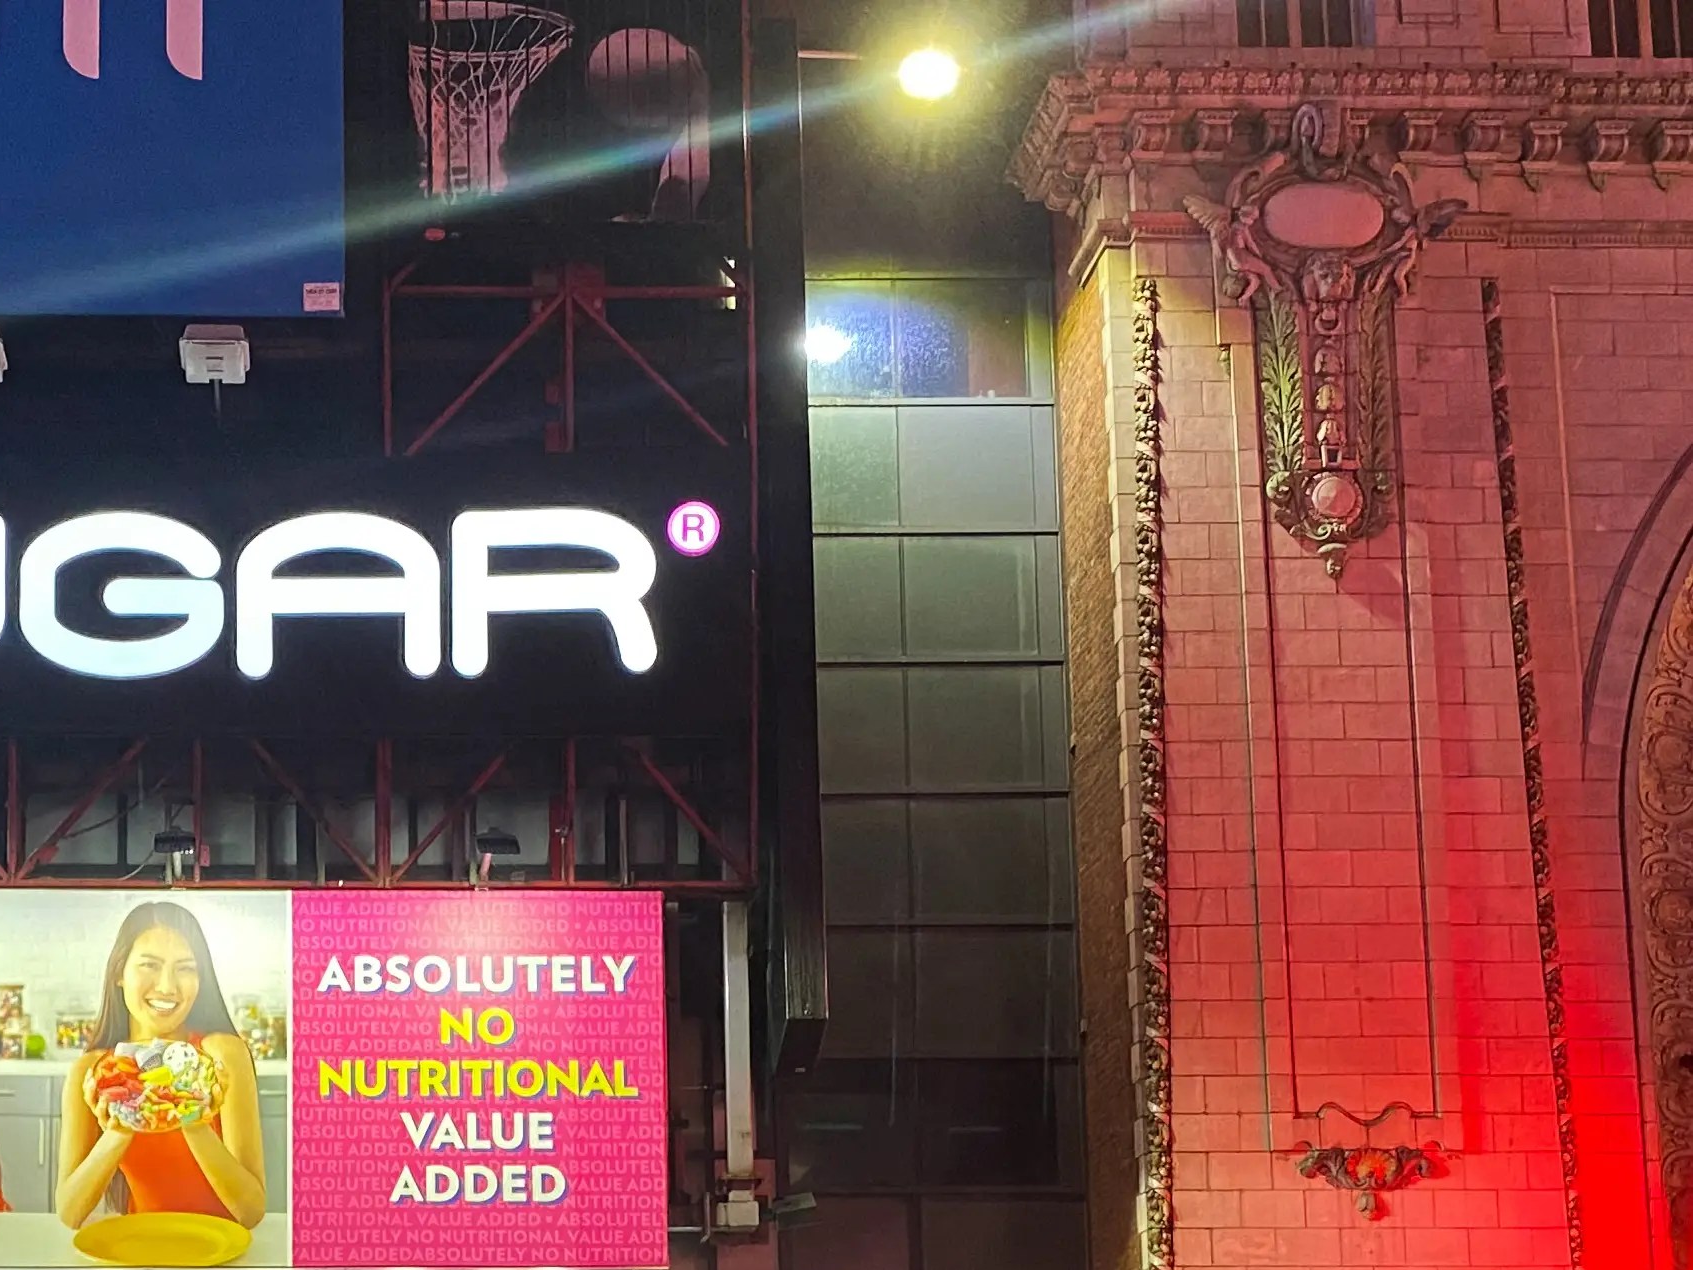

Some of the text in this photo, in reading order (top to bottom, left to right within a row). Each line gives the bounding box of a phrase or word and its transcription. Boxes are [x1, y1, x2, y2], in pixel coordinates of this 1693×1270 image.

[317, 954, 636, 995] ABSOLUTELY
[439, 1007, 516, 1046] NO
[318, 1059, 640, 1101] NUTRITIONAL
[399, 1111, 554, 1152] VALUE
[389, 1164, 569, 1205] ADDED
